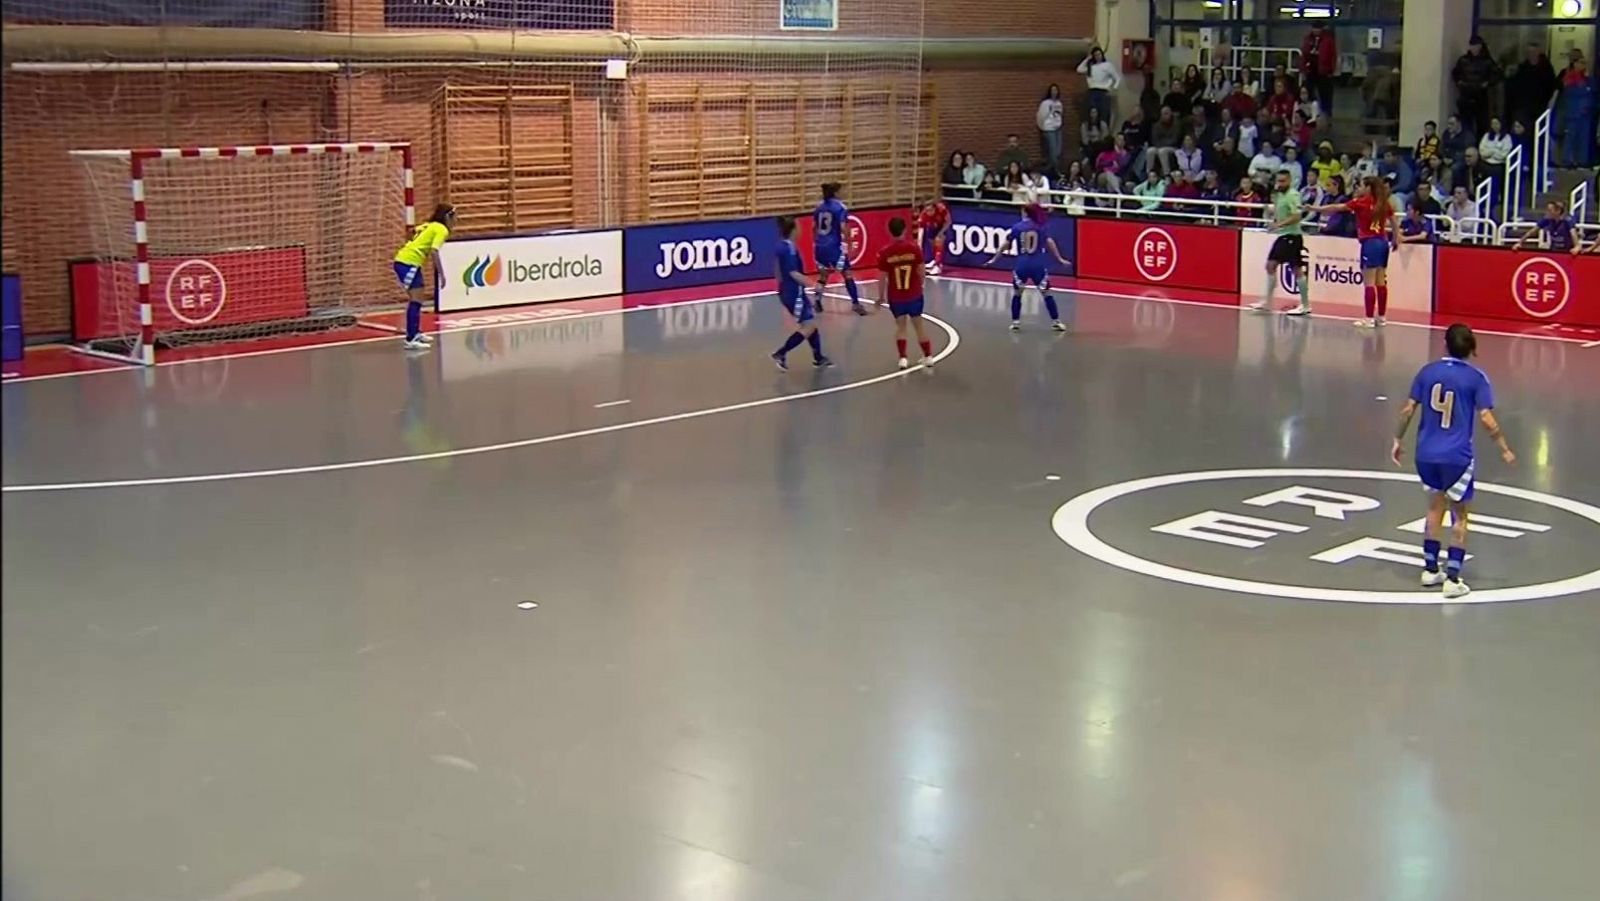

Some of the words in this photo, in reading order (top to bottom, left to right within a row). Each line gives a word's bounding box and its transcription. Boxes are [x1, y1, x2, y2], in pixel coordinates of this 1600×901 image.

[818, 211, 832, 236] 13
[948, 224, 1018, 256] Jom
[1020, 231, 1039, 254] 10
[507, 254, 603, 283] Iberdrola
[894, 264, 912, 290] 17
[1314, 263, 1364, 285] Mósto
[1430, 382, 1454, 429] 4
